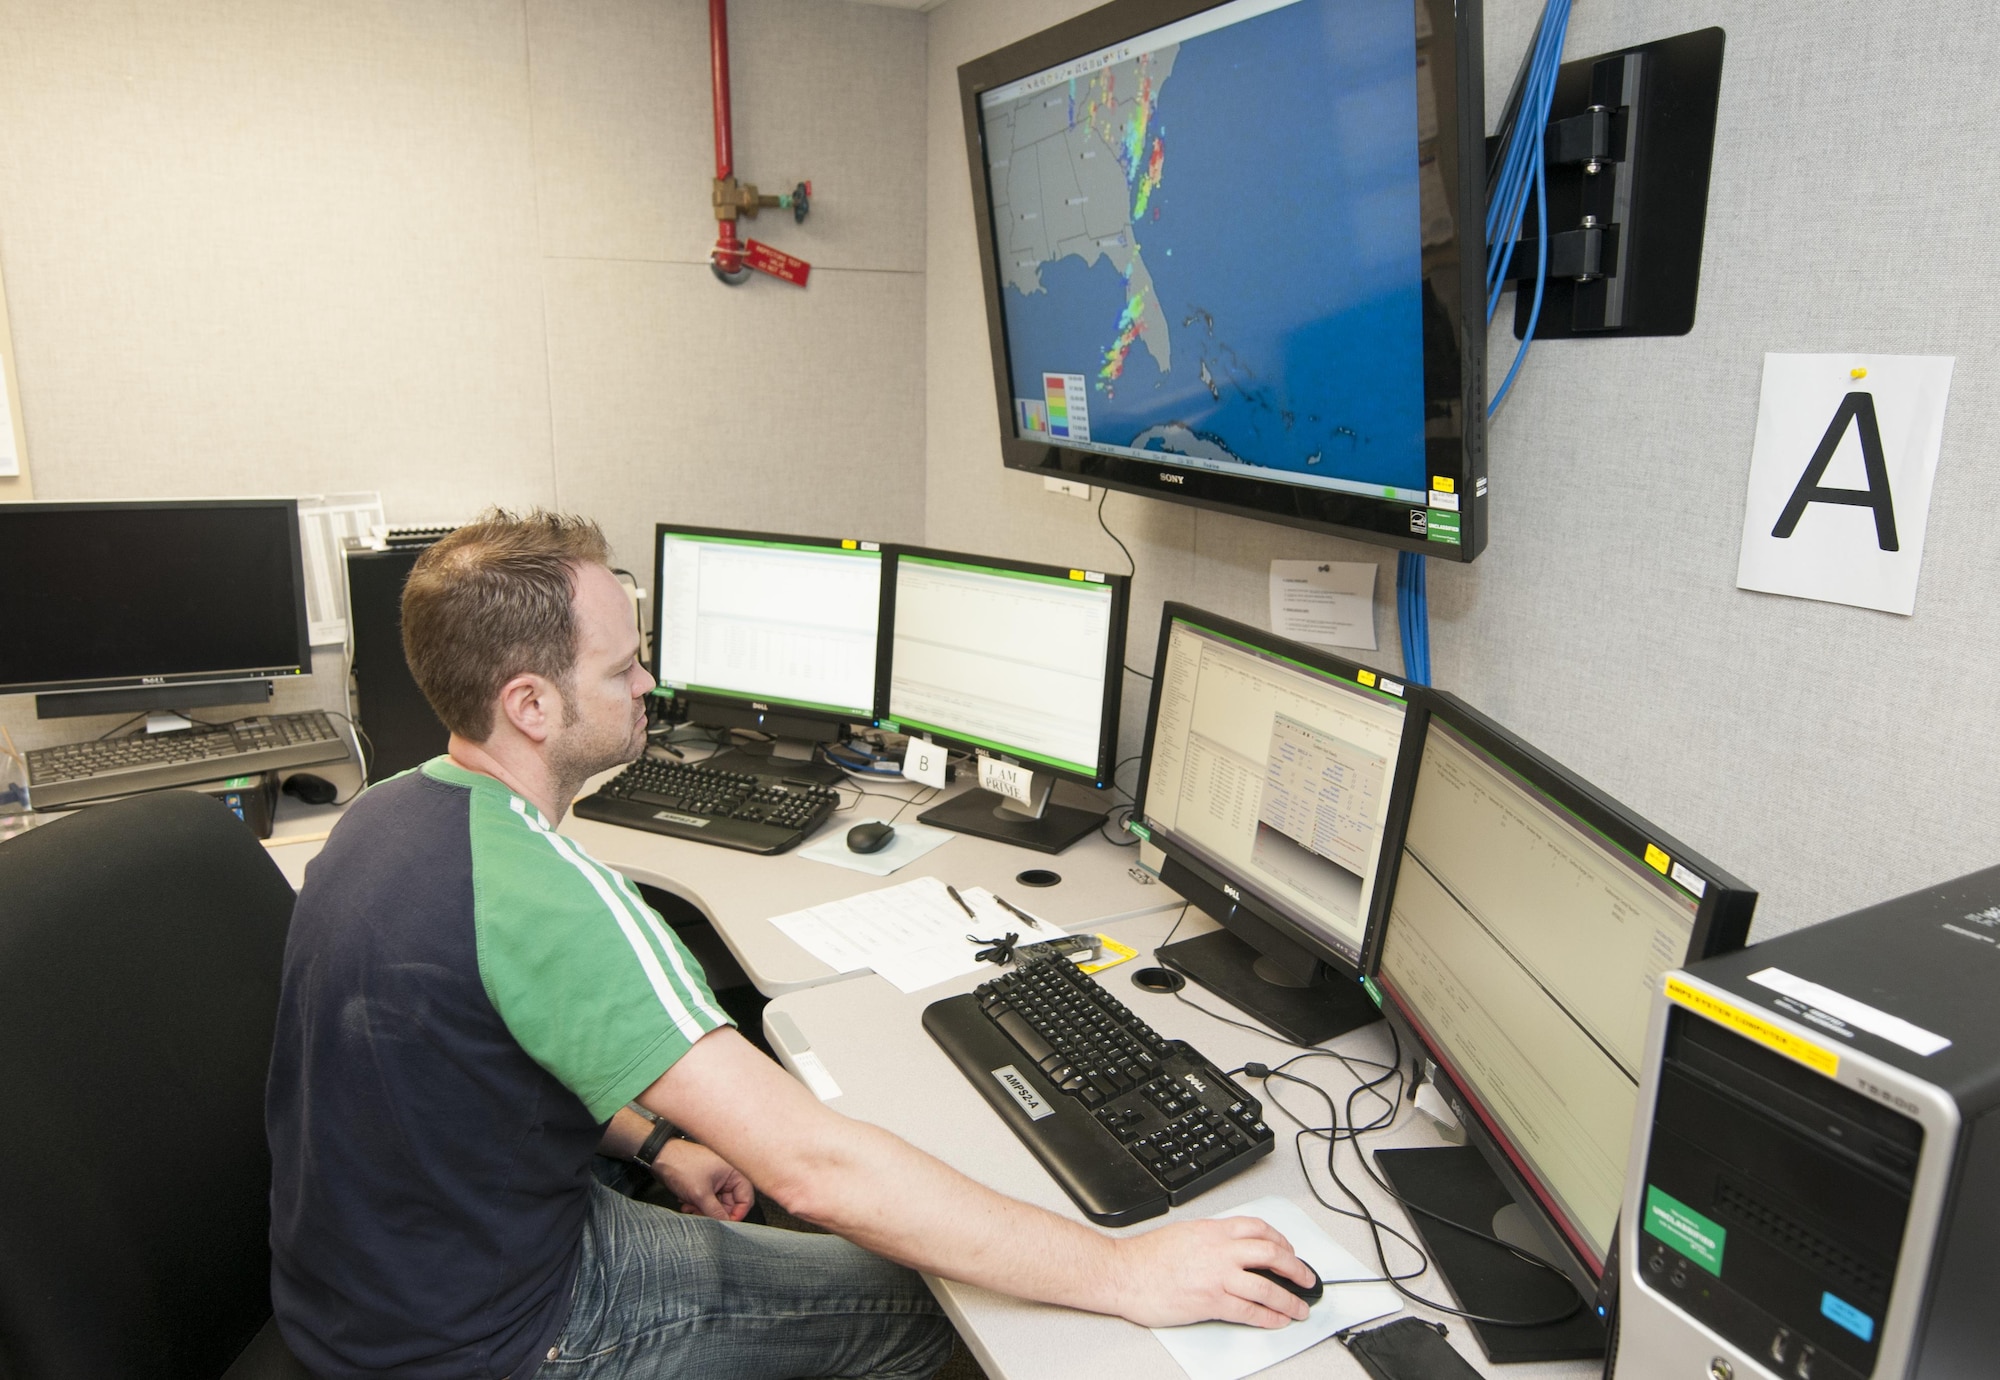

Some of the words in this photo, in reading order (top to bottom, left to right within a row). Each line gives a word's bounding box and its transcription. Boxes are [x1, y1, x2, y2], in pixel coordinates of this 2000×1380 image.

[1159, 472, 1184, 485] SONY
[1771, 391, 1900, 552] A
[142, 677, 166, 685] DELL
[752, 702, 769, 711] DELL
[919, 755, 930, 772] B
[1000, 769, 1018, 783] AM
[985, 777, 1021, 799] PRIME
[1223, 883, 1241, 901] DELL
[1695, 996, 1732, 1018] SYSTEM
[1734, 1015, 1789, 1045] COMPUTER
[1003, 1073, 1040, 1109] AMPS2-A
[1183, 1073, 1207, 1093] DELL
[1451, 1098, 1467, 1126] DELL
